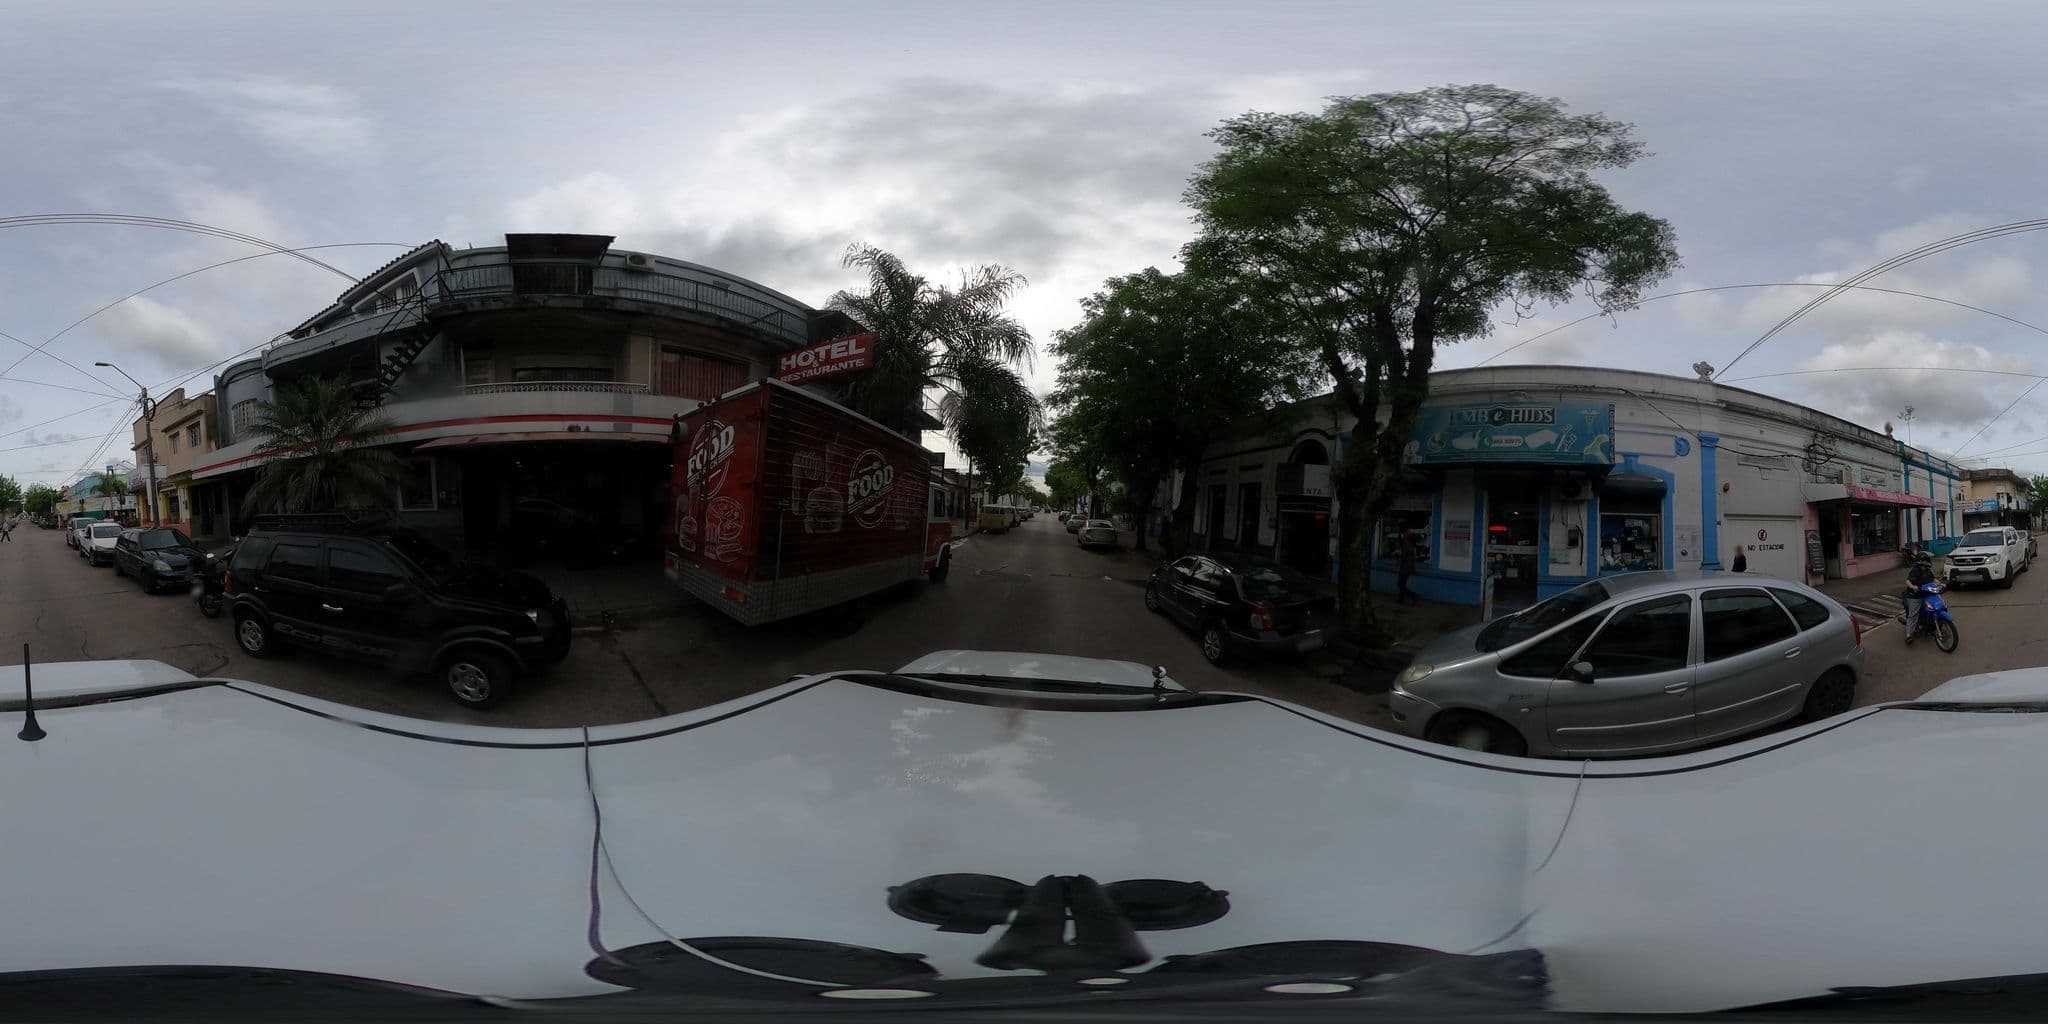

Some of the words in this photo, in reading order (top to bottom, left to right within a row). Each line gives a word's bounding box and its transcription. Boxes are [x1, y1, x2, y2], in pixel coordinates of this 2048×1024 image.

[781, 339, 865, 370] HOTEL
[781, 358, 864, 382] RESTAURANTE
[687, 425, 735, 477] FOOD
[848, 465, 894, 504] FOOD
